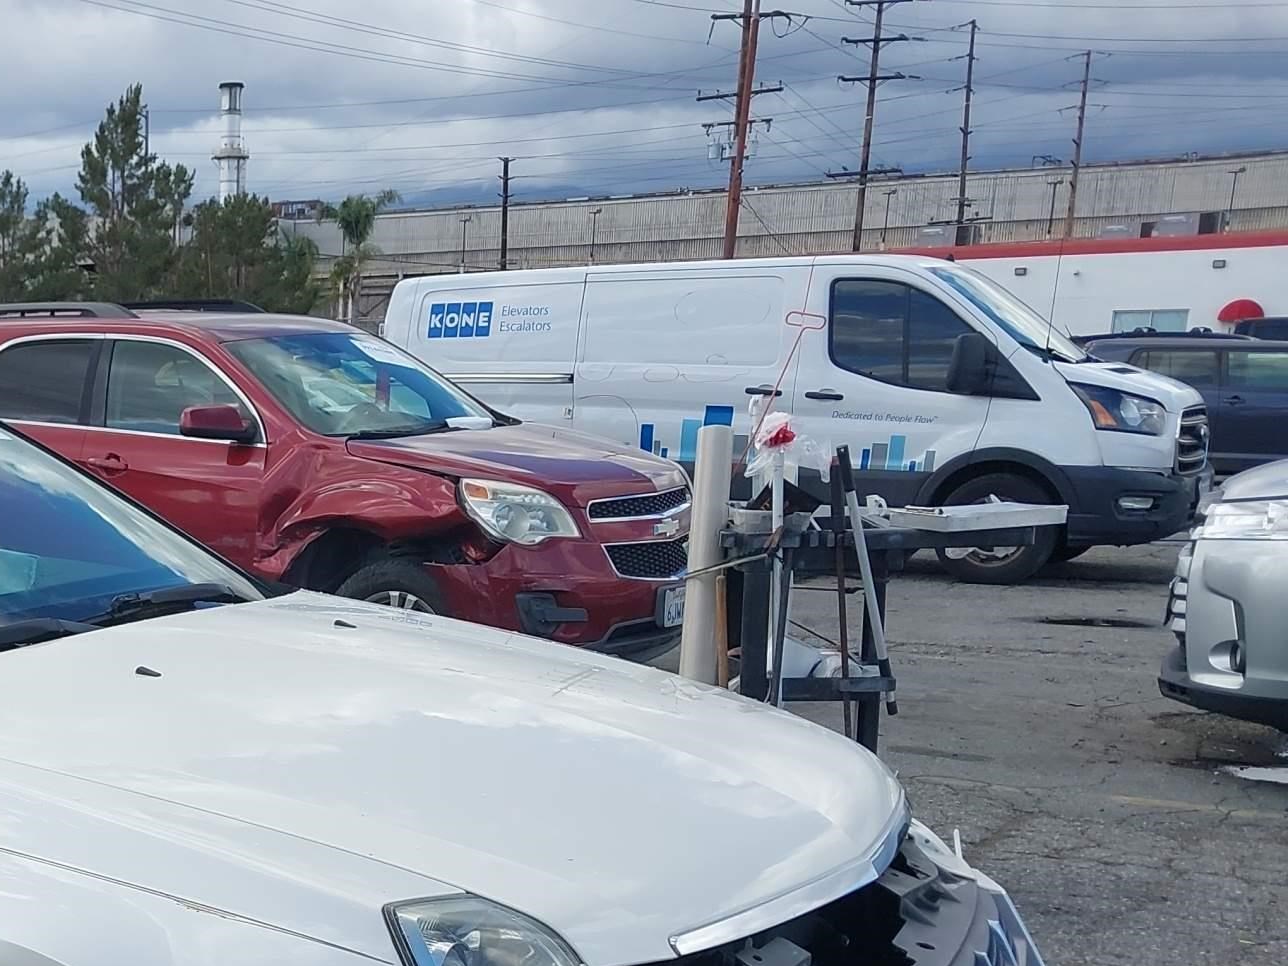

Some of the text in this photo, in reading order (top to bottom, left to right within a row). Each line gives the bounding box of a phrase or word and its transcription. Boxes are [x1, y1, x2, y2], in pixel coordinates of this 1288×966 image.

[501, 305, 549, 317] Elevators
[430, 311, 490, 329] KONE
[499, 320, 552, 333] Escalators
[831, 410, 873, 421] Dedicated
[874, 413, 884, 422] to
[885, 413, 913, 424] People
